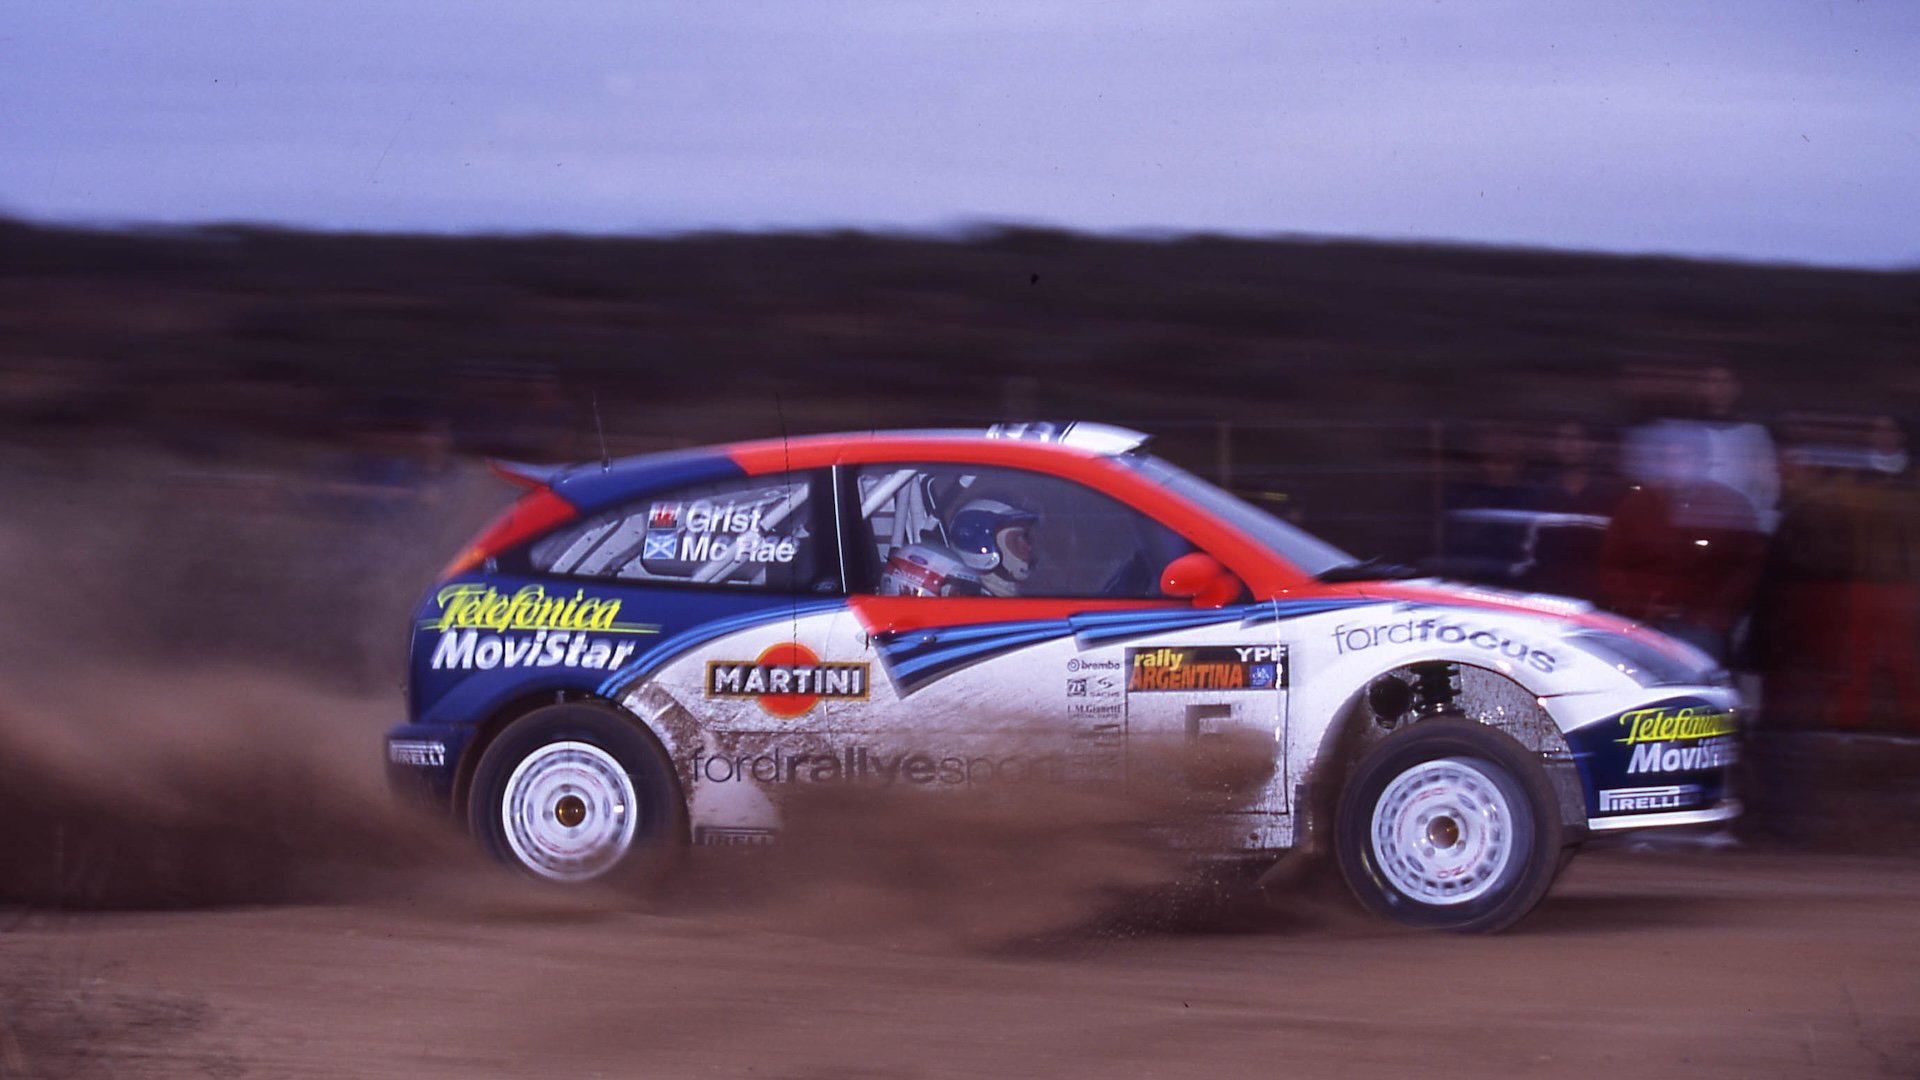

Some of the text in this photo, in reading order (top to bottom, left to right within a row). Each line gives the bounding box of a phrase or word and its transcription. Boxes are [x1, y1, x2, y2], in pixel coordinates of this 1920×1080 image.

[686, 501, 762, 533] Grist
[431, 628, 637, 670] MoviStar
[1234, 646, 1287, 662] YPF
[1331, 618, 1557, 673] fordfocus
[1133, 649, 1183, 671] rally
[714, 667, 862, 695] MARTINI
[1128, 663, 1244, 690] ARGENTINA
[1600, 786, 1680, 811] PIRELLI
